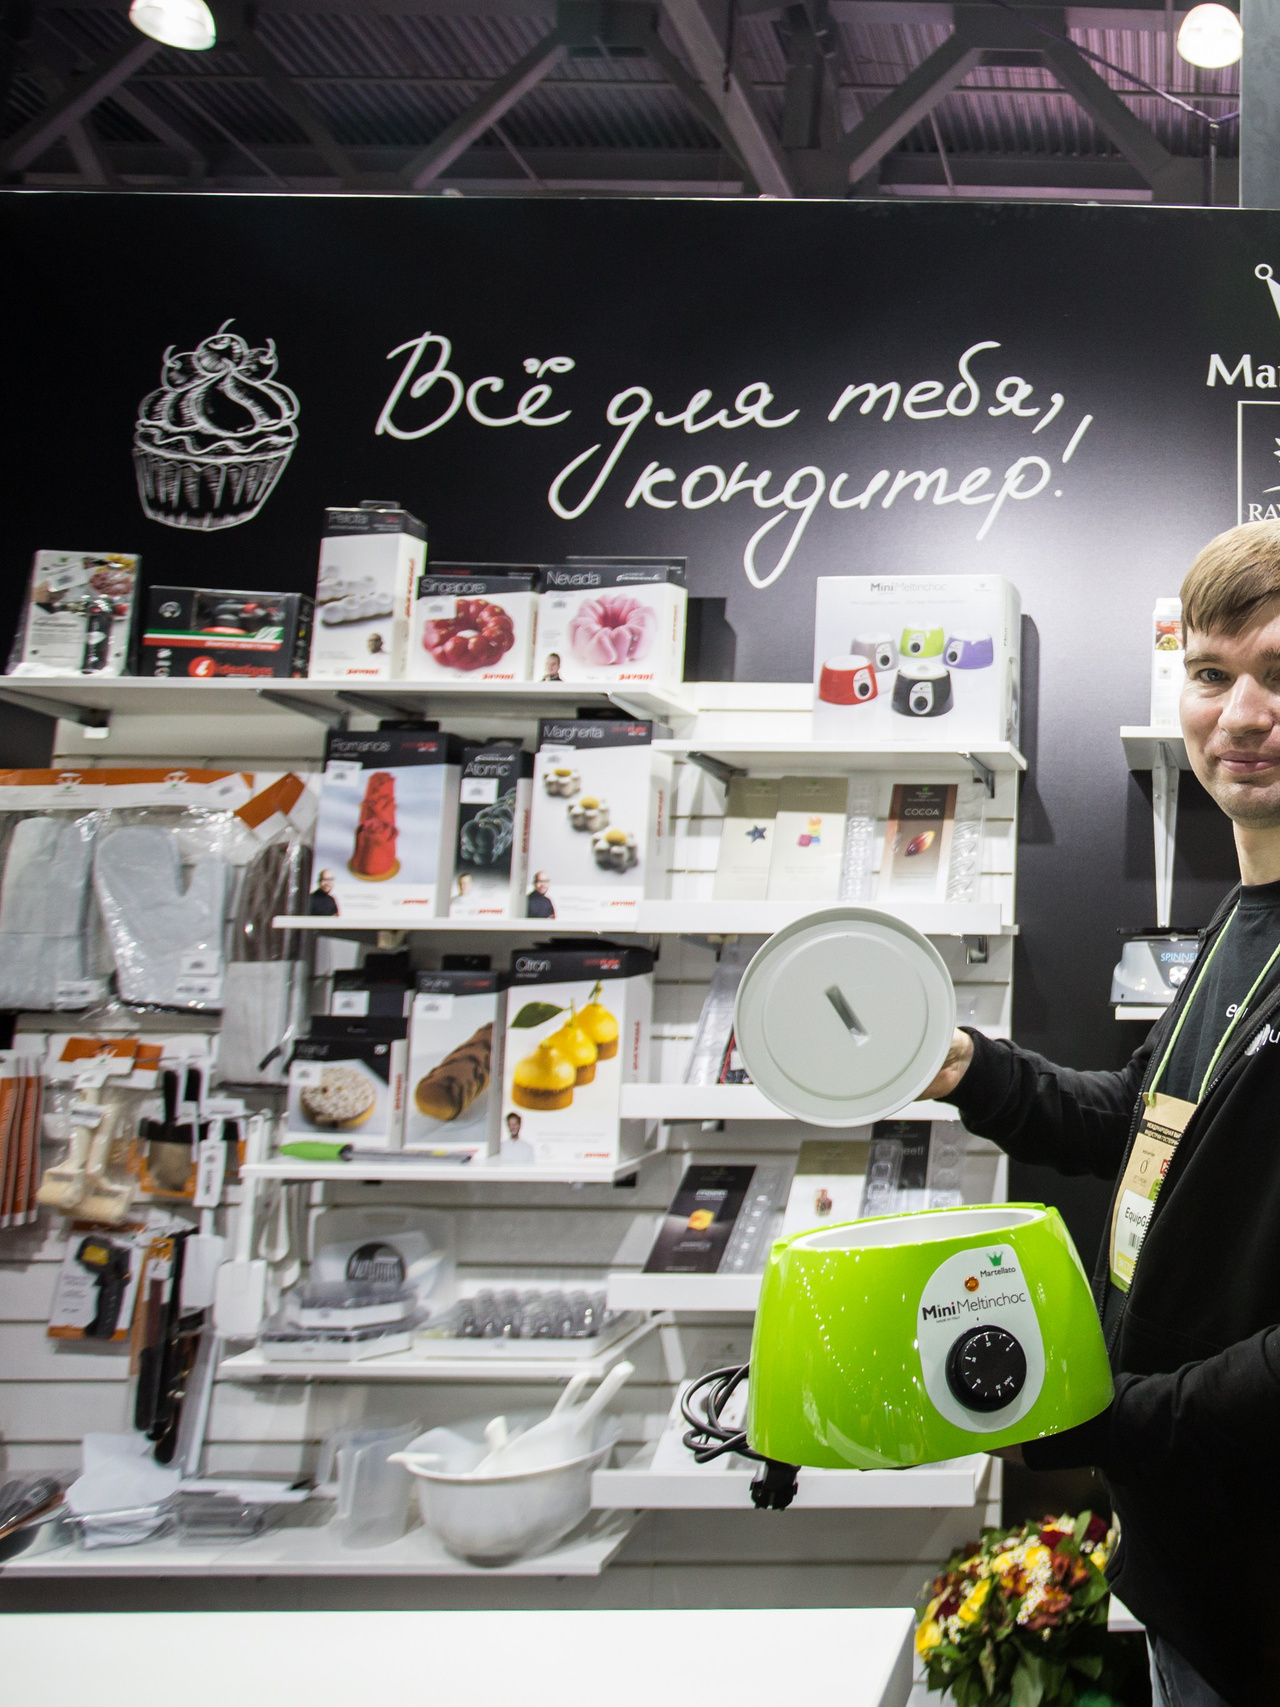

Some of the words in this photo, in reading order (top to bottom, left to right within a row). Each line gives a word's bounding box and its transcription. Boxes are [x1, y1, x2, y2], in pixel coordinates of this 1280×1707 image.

[375, 331, 576, 440] Всё
[547, 382, 800, 520] для
[828, 340, 1066, 434] тебя,
[625, 414, 1094, 590] кондитер!
[546, 571, 601, 586] Nevada
[420, 578, 488, 595] Singapore
[543, 725, 604, 740] Margherita
[464, 762, 511, 776] Atomic
[904, 808, 940, 816] COCOA
[515, 956, 551, 972] Citron
[980, 1266, 1016, 1279] Martellato
